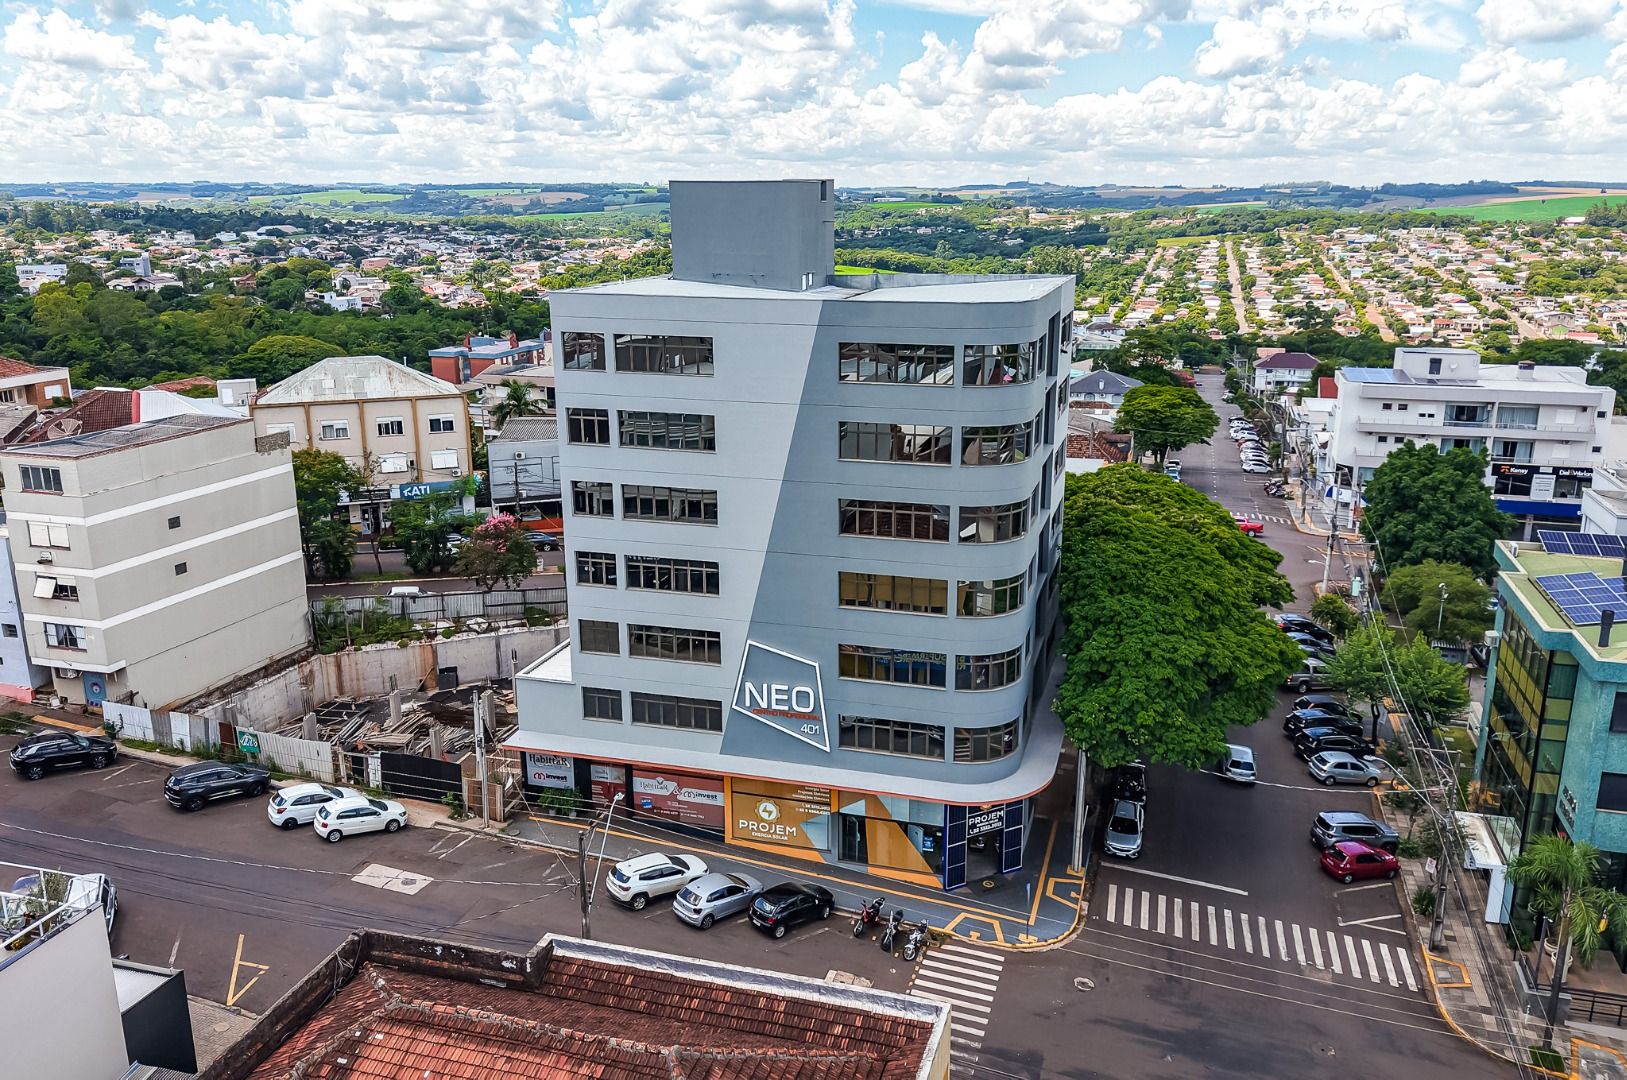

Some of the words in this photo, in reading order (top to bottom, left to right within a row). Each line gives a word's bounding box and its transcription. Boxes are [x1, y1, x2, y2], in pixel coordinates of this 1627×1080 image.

[744, 681, 815, 713] NEO
[800, 724, 820, 735] 401
[968, 810, 1004, 825] PROJEM
[739, 819, 797, 837] PROJEM
